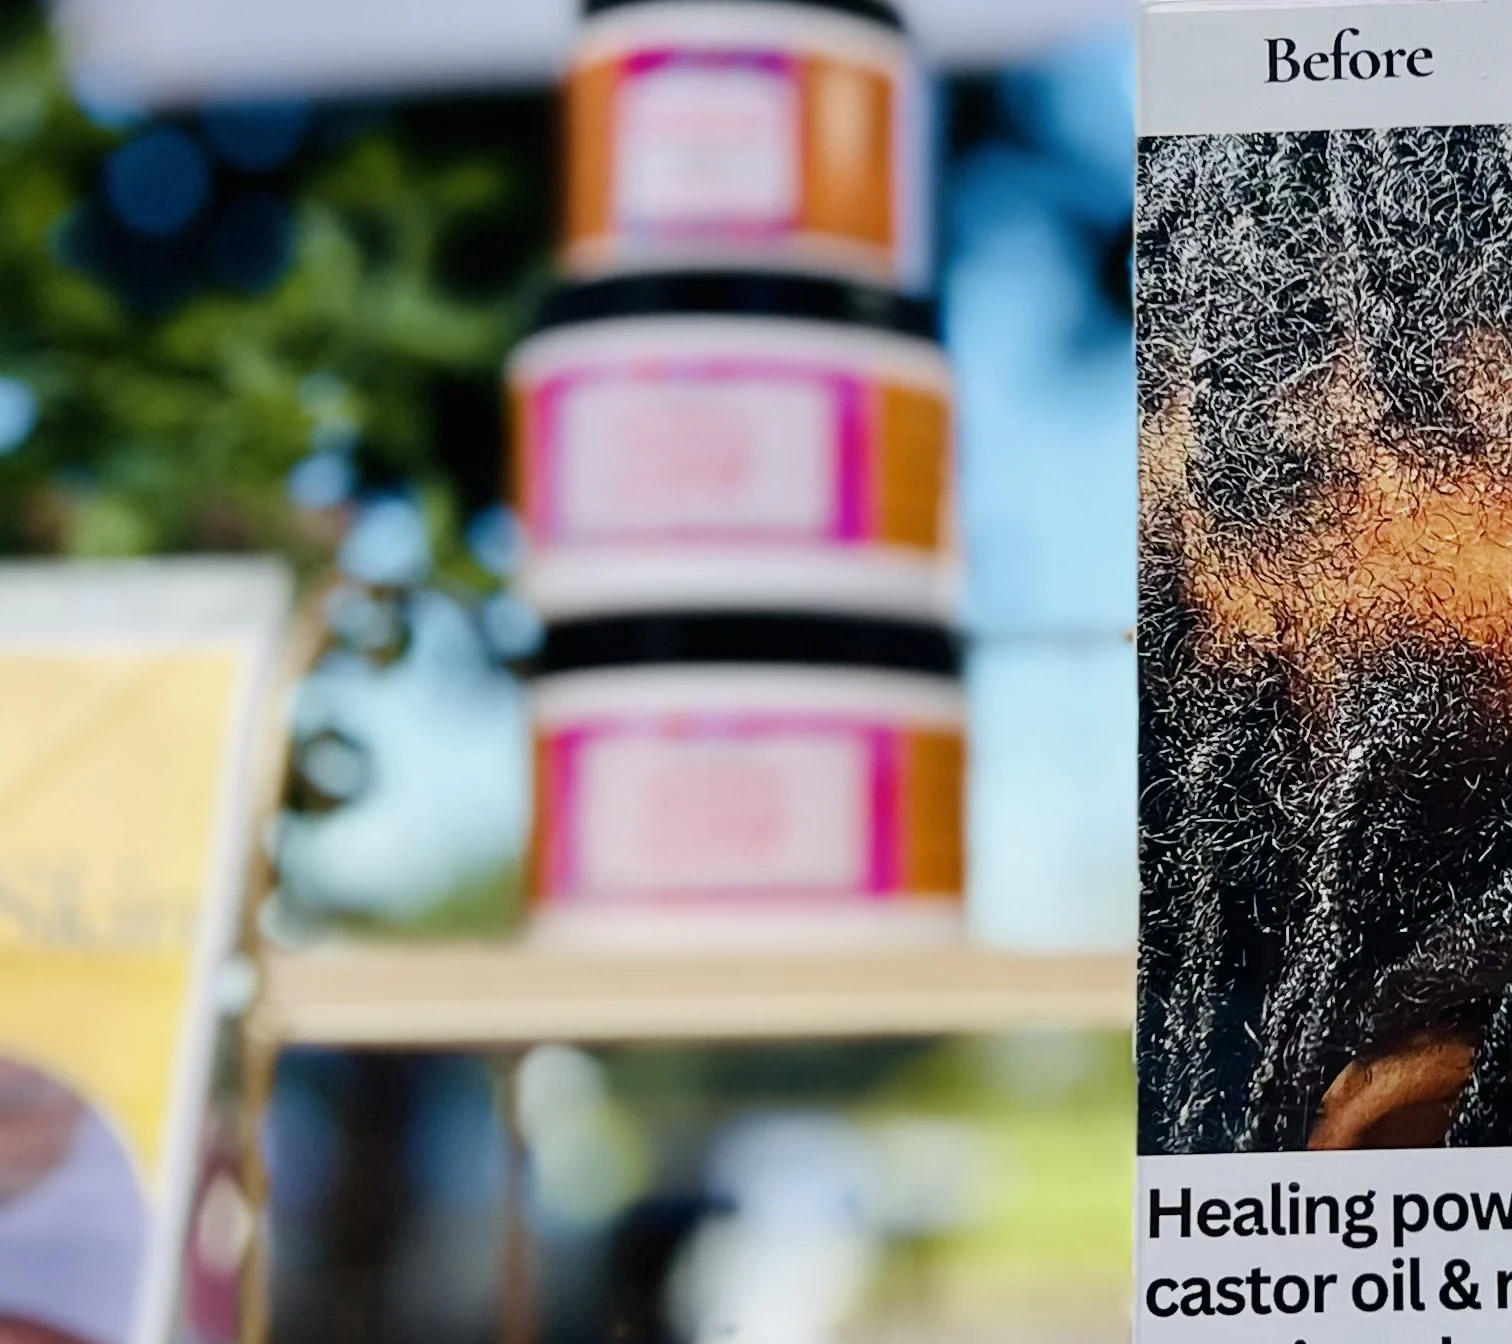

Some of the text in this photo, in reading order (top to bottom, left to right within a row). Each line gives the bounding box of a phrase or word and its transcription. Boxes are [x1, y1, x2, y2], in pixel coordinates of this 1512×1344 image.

[1264, 26, 1435, 84] Before
[1148, 1180, 1379, 1251] Healing
[1145, 1266, 1339, 1319] castor
[1350, 1255, 1427, 1314] oil
[1437, 1257, 1483, 1312] &
